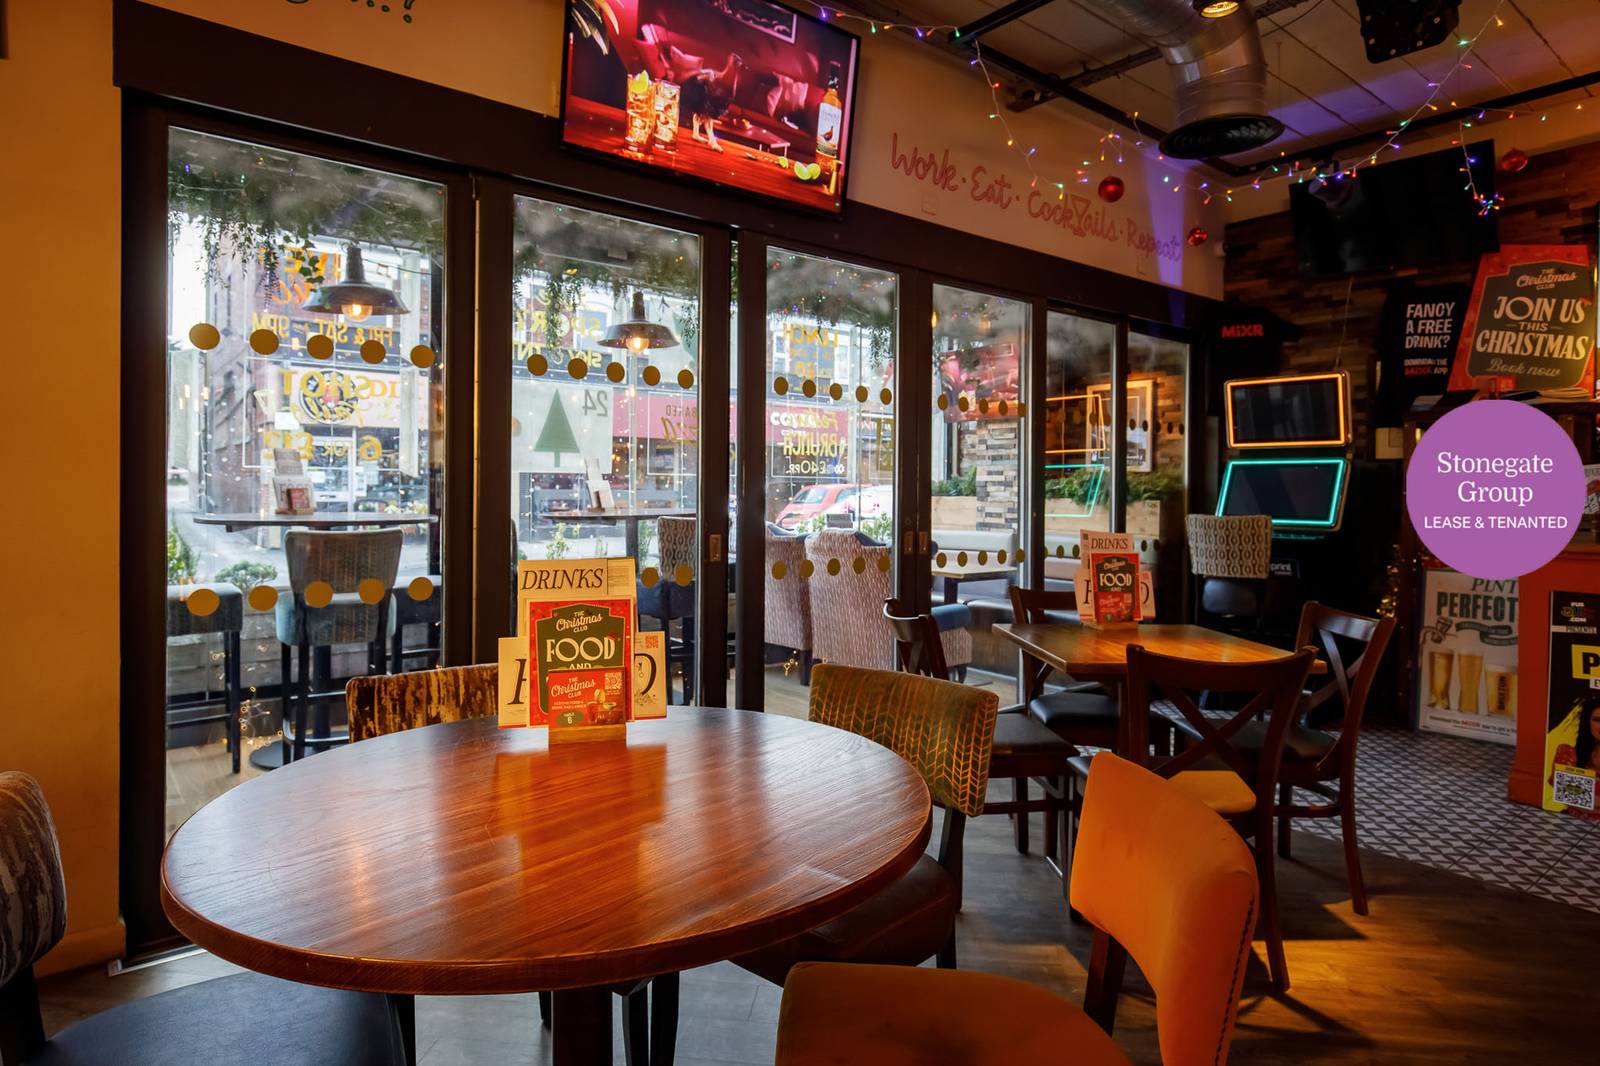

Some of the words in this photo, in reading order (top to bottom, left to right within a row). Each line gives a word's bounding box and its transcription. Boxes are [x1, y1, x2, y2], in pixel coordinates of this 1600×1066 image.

[891, 132, 959, 191] Work
[971, 165, 1013, 210] Eat
[1127, 217, 1182, 262] Repeat
[1516, 272, 1578, 288] Christmas
[1406, 302, 1455, 318] FANCY
[1493, 296, 1556, 321] JOIN
[1560, 298, 1586, 323] US
[1406, 320, 1414, 334] A
[1417, 319, 1453, 334] FREE
[1519, 321, 1549, 331] THIS
[1405, 335, 1450, 349] DRINK?
[1475, 329, 1590, 360] CHRISTMAS
[1487, 358, 1527, 374] Book
[1527, 365, 1561, 377] now
[1091, 538, 1128, 549] DRINKS
[521, 568, 604, 591] DRINKS
[1099, 573, 1132, 587] FOOD
[1471, 578, 1518, 594] PINT
[1436, 591, 1519, 623] PERFECT
[556, 613, 603, 632] Christmas
[573, 625, 588, 633] CLUB
[546, 637, 616, 663] FOOD
[551, 678, 596, 697] Christmas
[568, 690, 582, 699] CLUB
